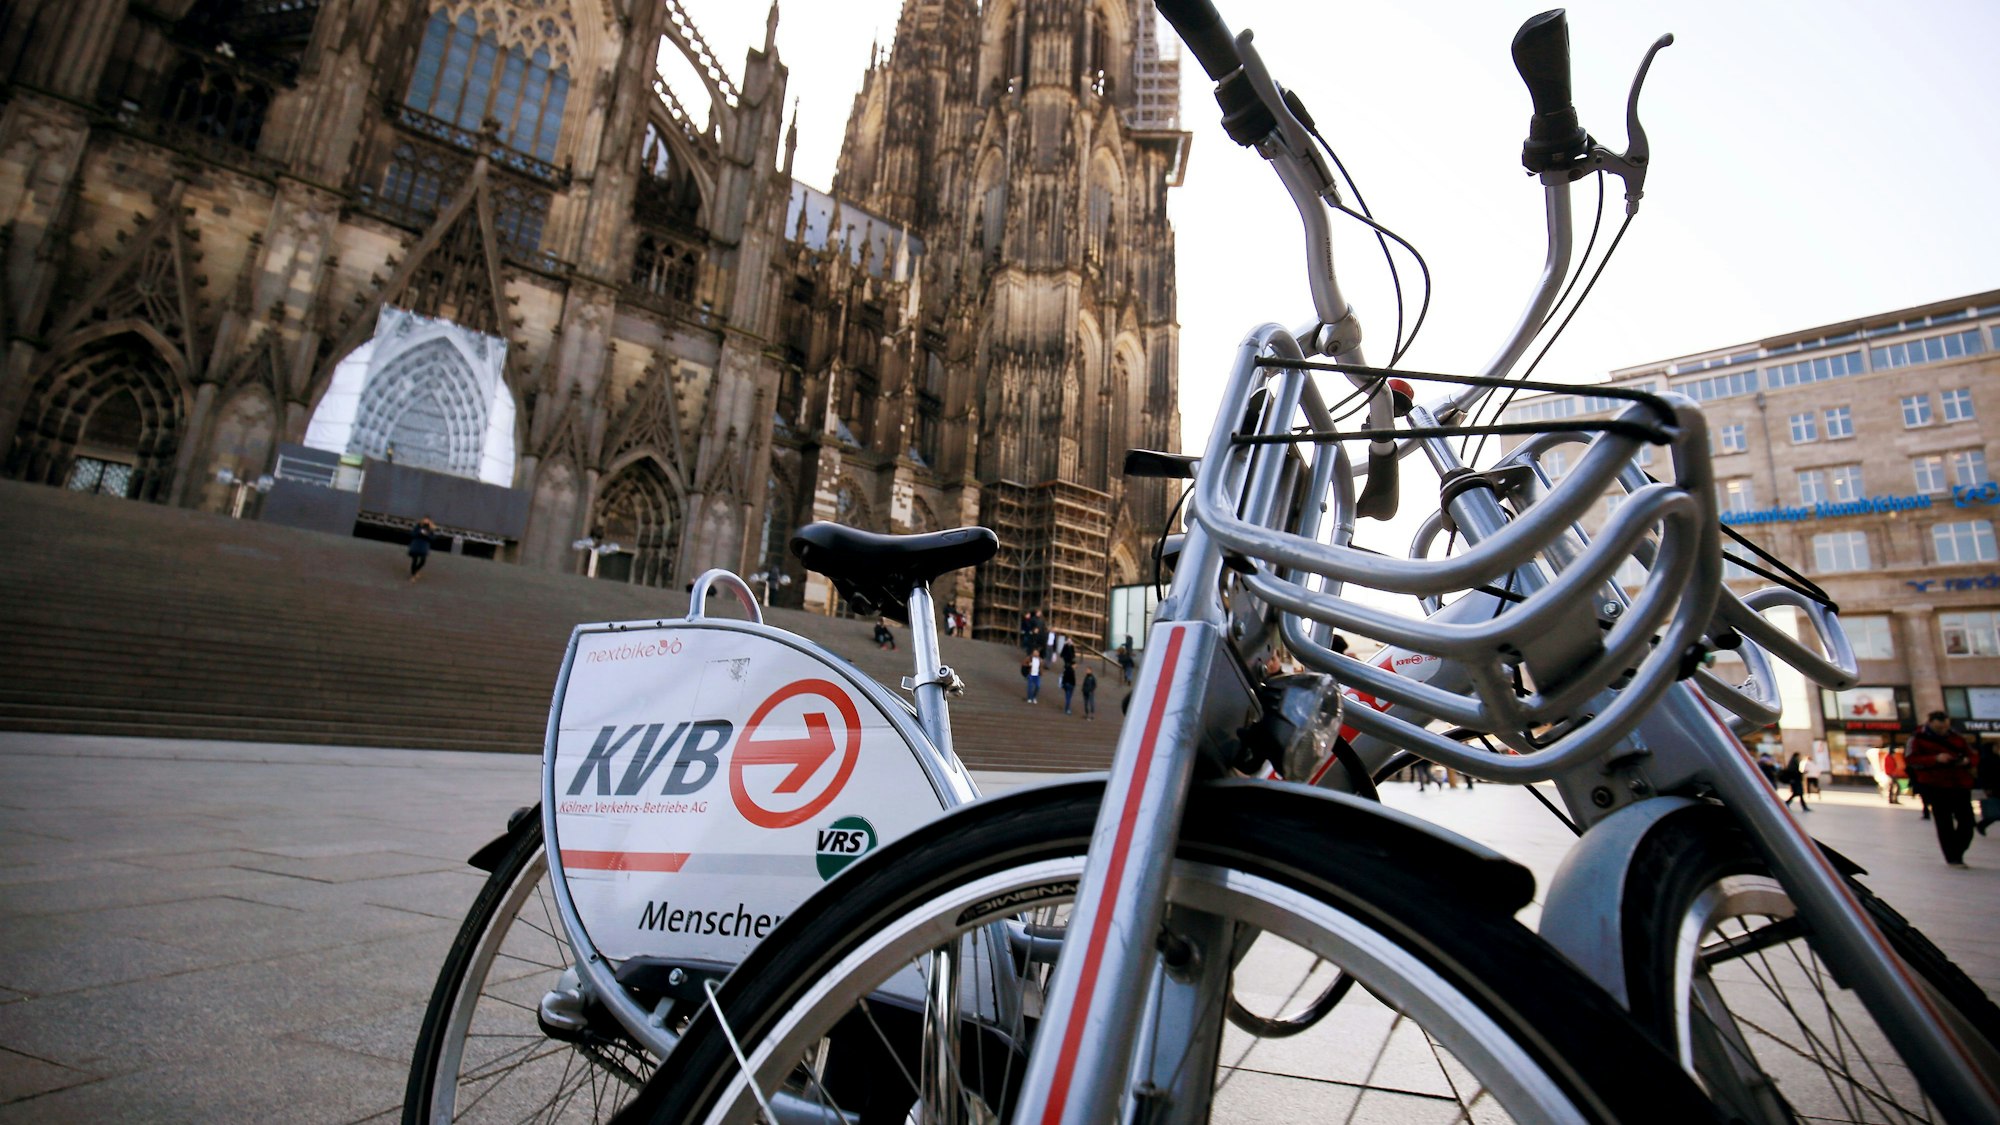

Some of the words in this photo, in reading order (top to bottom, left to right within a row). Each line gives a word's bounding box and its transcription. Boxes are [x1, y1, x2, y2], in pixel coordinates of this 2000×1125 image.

[586, 641, 656, 664] nextbike
[566, 719, 733, 796] KVB
[559, 801, 593, 814] Kölner
[594, 801, 688, 814] Verkehrs-Betriebe
[690, 801, 708, 814] AG
[817, 830, 864, 853] VRS
